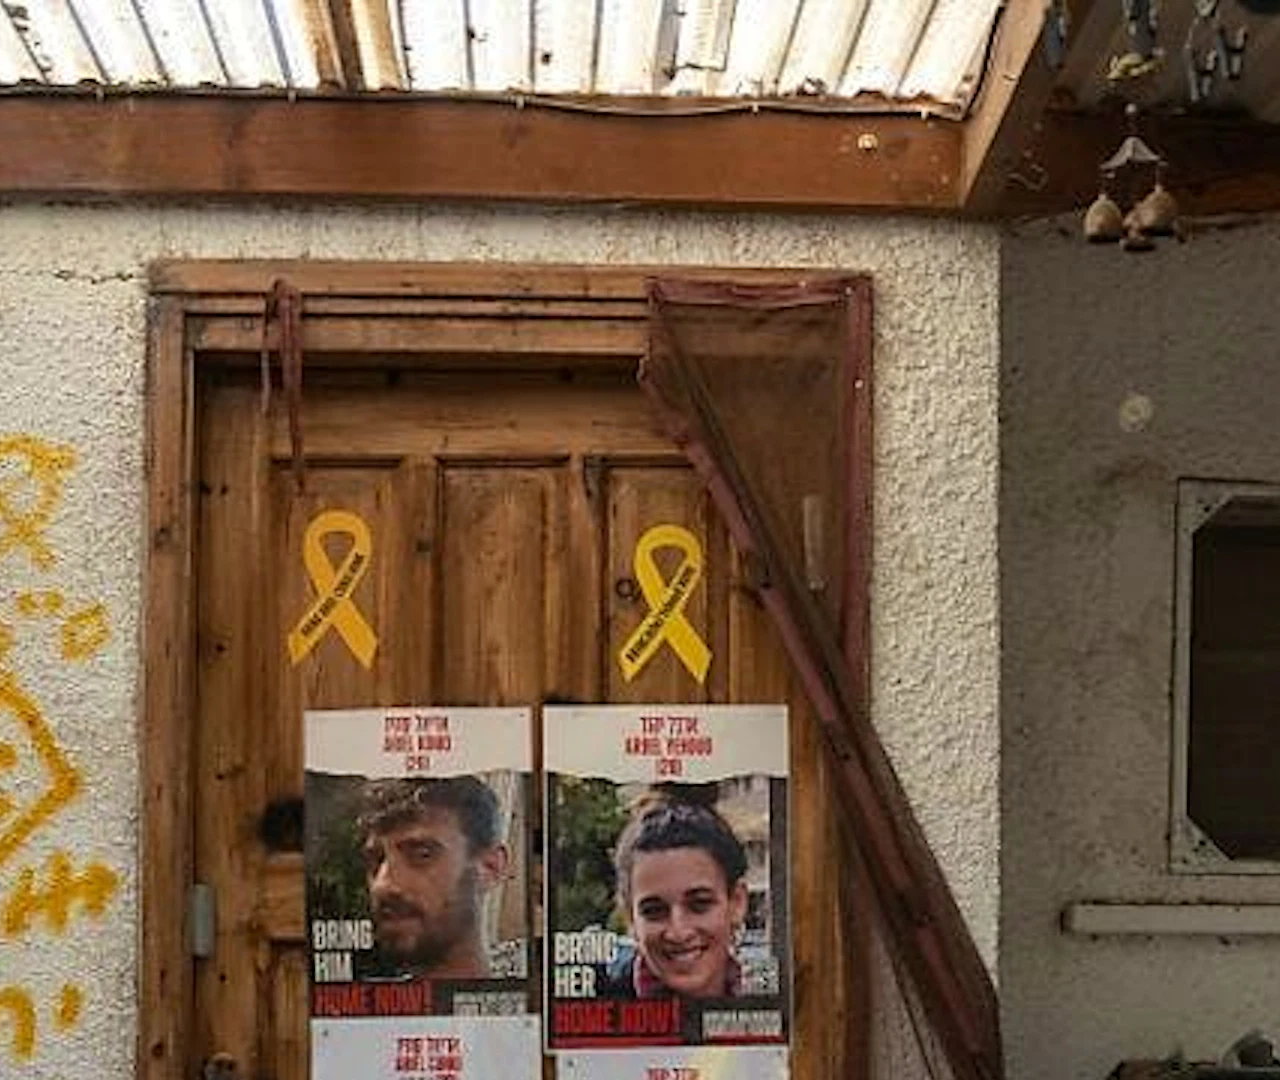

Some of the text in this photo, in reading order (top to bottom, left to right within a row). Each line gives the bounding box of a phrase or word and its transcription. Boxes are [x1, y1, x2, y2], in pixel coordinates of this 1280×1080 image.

[312, 918, 375, 950] BRING
[553, 928, 619, 965] BRING
[314, 950, 354, 983] HIM
[554, 964, 597, 998] HER
[314, 982, 371, 1015] HOME
[374, 980, 432, 1015] NOW!
[554, 1000, 616, 1034] HOME
[621, 998, 682, 1034] NOW!
